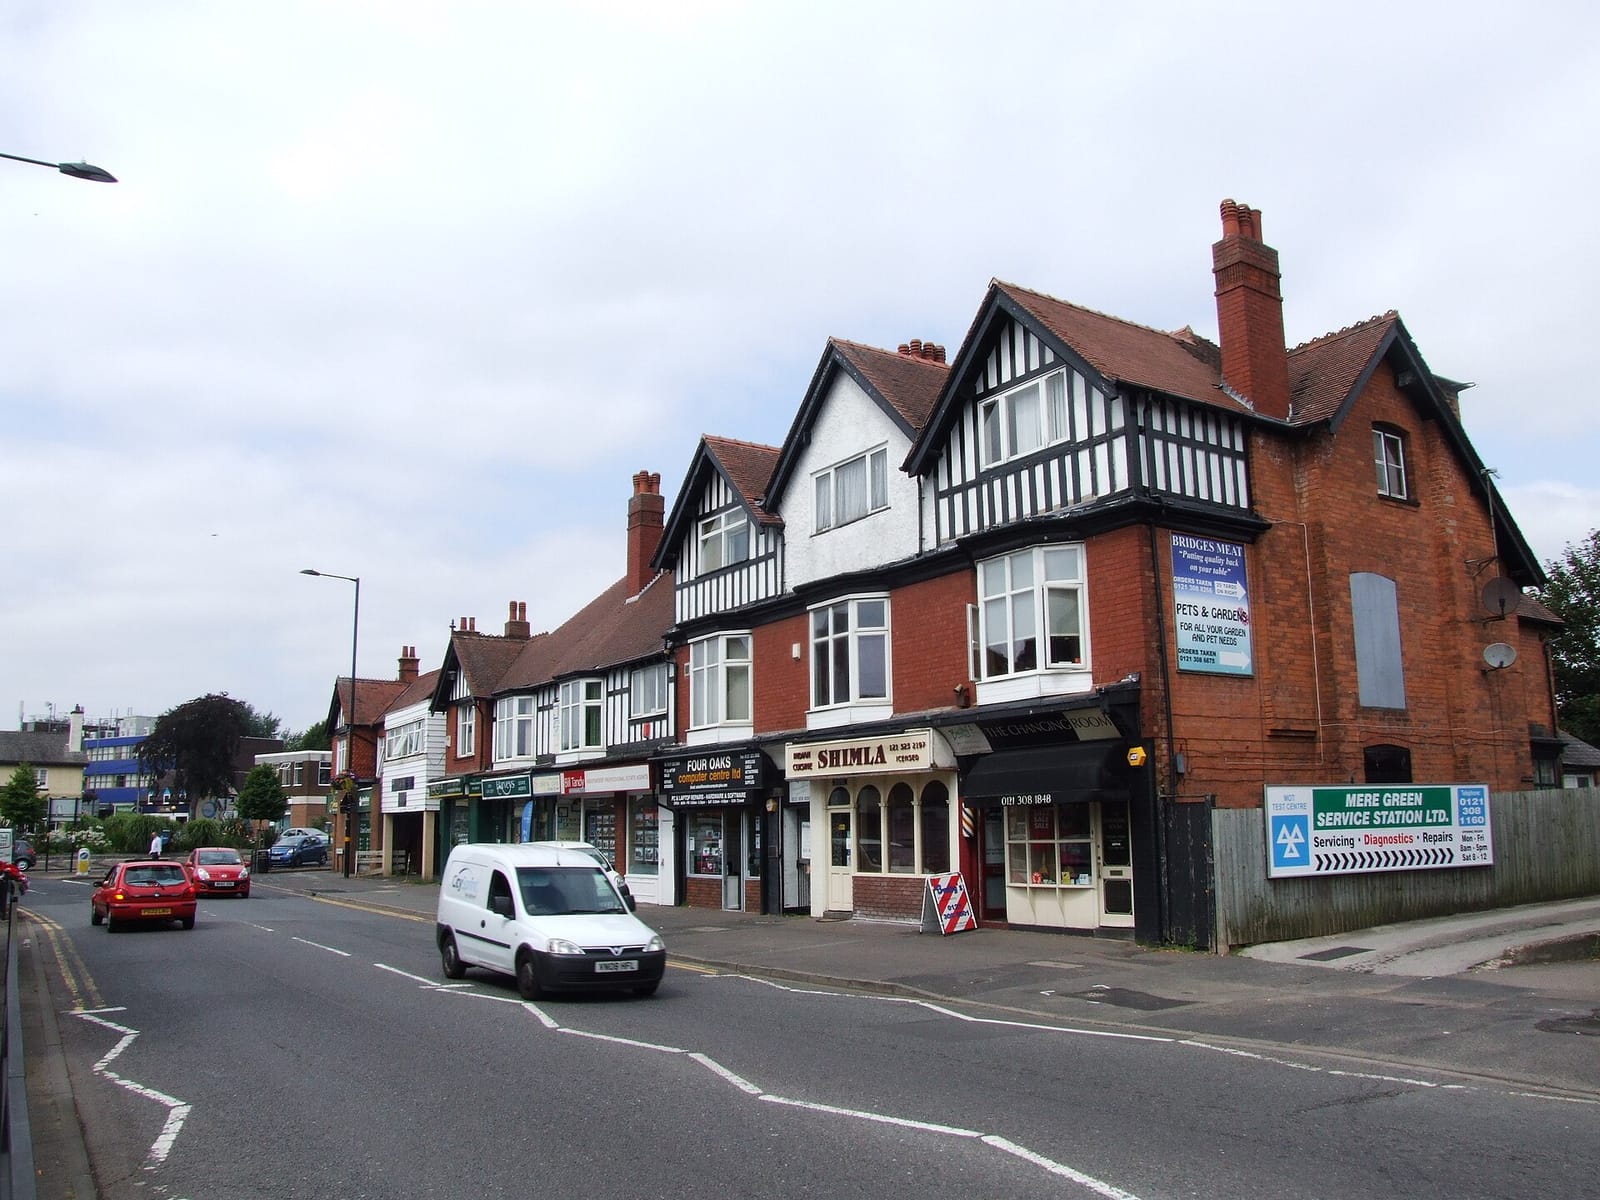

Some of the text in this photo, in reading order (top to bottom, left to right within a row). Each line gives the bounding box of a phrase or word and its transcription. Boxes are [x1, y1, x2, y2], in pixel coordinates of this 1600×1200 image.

[1173, 535, 1242, 557] BRIDGES MEAT
[1204, 556, 1225, 566] quality
[1226, 557, 1239, 566] back
[1198, 566, 1212, 574] your
[1173, 576, 1195, 584] ORDERS
[1176, 603, 1248, 623] PETS & GARDENS
[1180, 622, 1246, 637] FOR ALL YOUR GARDEN
[1192, 633, 1237, 646] AND PET NEEDS
[1200, 649, 1216, 657] TAKEN
[985, 727, 1009, 737] THE
[1008, 719, 1071, 736] CHANGING
[1070, 713, 1113, 728] ROOM
[793, 751, 811, 760] INDIAN
[817, 744, 887, 769] SHIMLA
[687, 758, 707, 772] FOUR
[709, 755, 731, 769] OAKS
[792, 762, 813, 771] CUISINE
[571, 776, 585, 788] Tandy
[678, 772, 708, 785] computer
[709, 769, 730, 781] centre
[731, 767, 741, 779] ltd
[1017, 794, 1033, 805] 308
[1034, 793, 1052, 804] 1848
[1345, 792, 1423, 807] MERE GREEN
[1459, 797, 1484, 806] 0121
[1286, 802, 1307, 810] CENTRE
[1462, 807, 1481, 815] 308
[1317, 809, 1449, 827] SERVICE STATION LTD.
[1460, 816, 1485, 824] 1160
[1314, 832, 1453, 848] Servicing Diagnostics Repairs
[1462, 834, 1473, 842] Mon
[1460, 844, 1471, 852] 8am
[1476, 844, 1488, 852] 5pm
